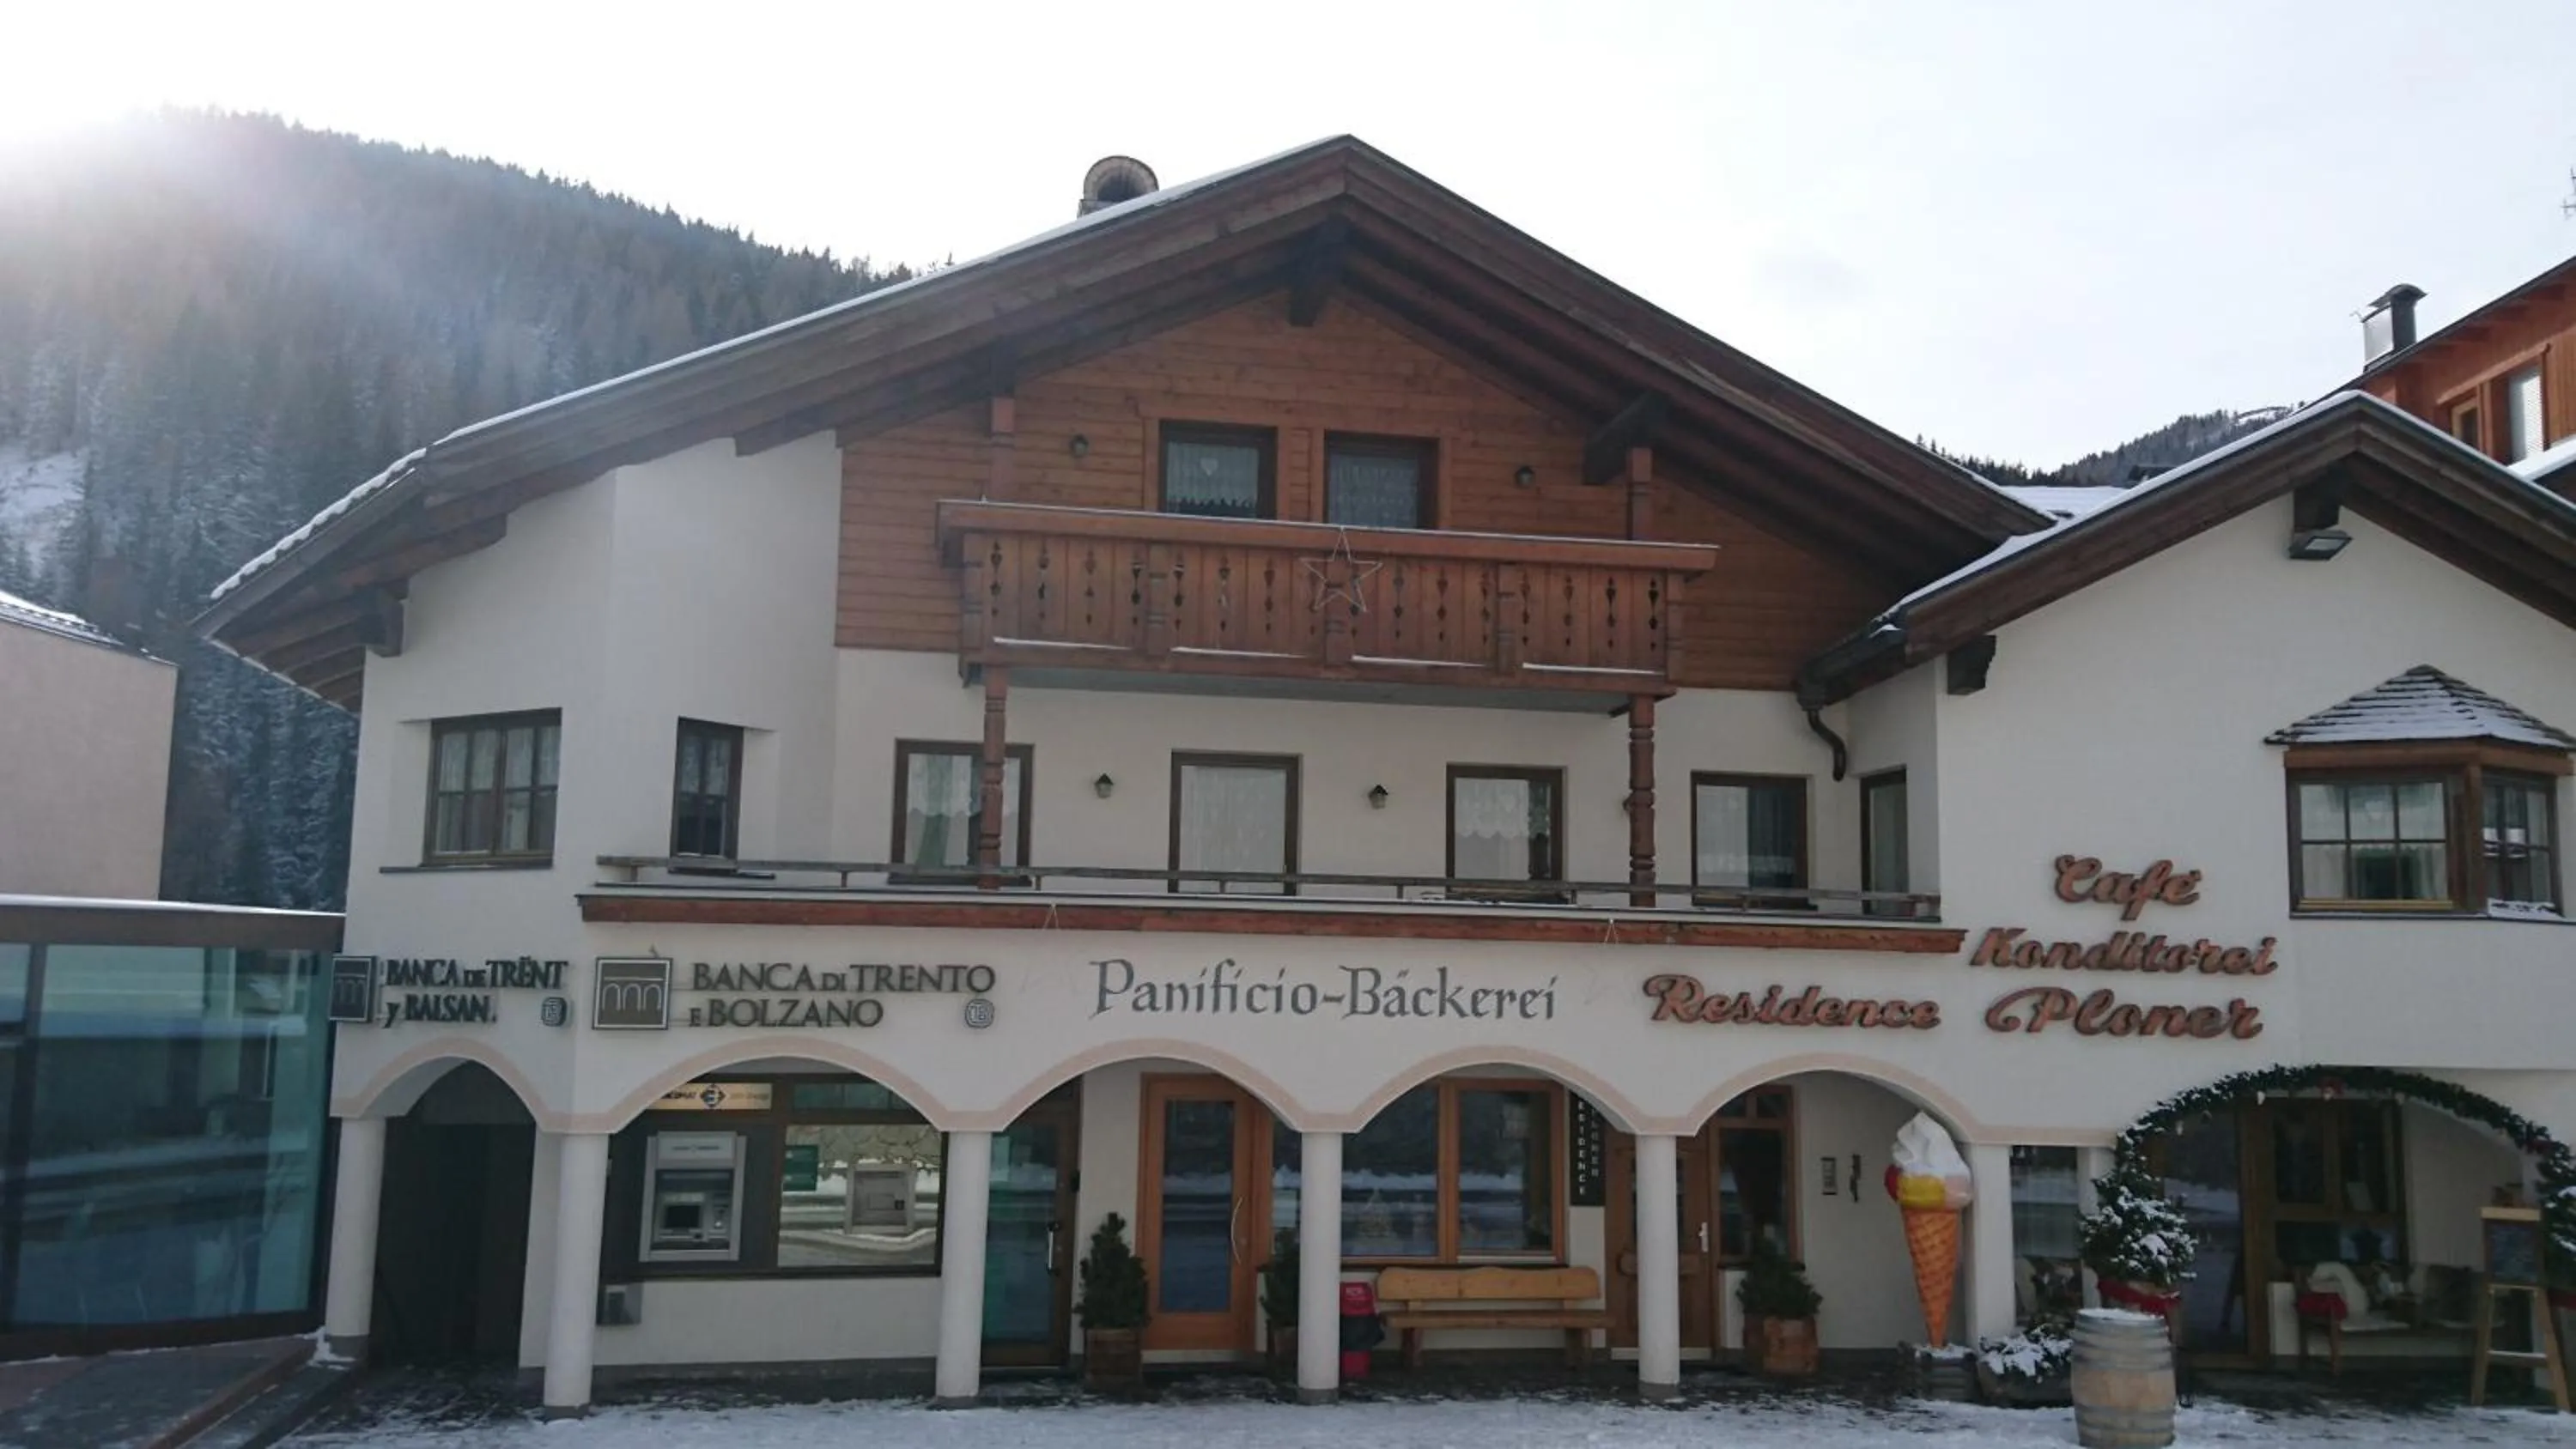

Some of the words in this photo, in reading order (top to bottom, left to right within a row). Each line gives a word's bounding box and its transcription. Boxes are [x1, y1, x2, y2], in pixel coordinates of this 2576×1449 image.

[1969, 927, 2279, 976] Konditorei
[386, 959, 457, 986] BANCA
[464, 969, 486, 988] DE
[486, 956, 568, 989] TRËNT
[692, 962, 815, 991] BANCA
[820, 972, 848, 991] DI
[849, 964, 996, 993] TRENTO
[690, 1008, 702, 1027] E
[708, 998, 884, 1028] BOLZANO
[1642, 973, 1941, 1029] Residence
[1984, 986, 2263, 1039] Ploner
